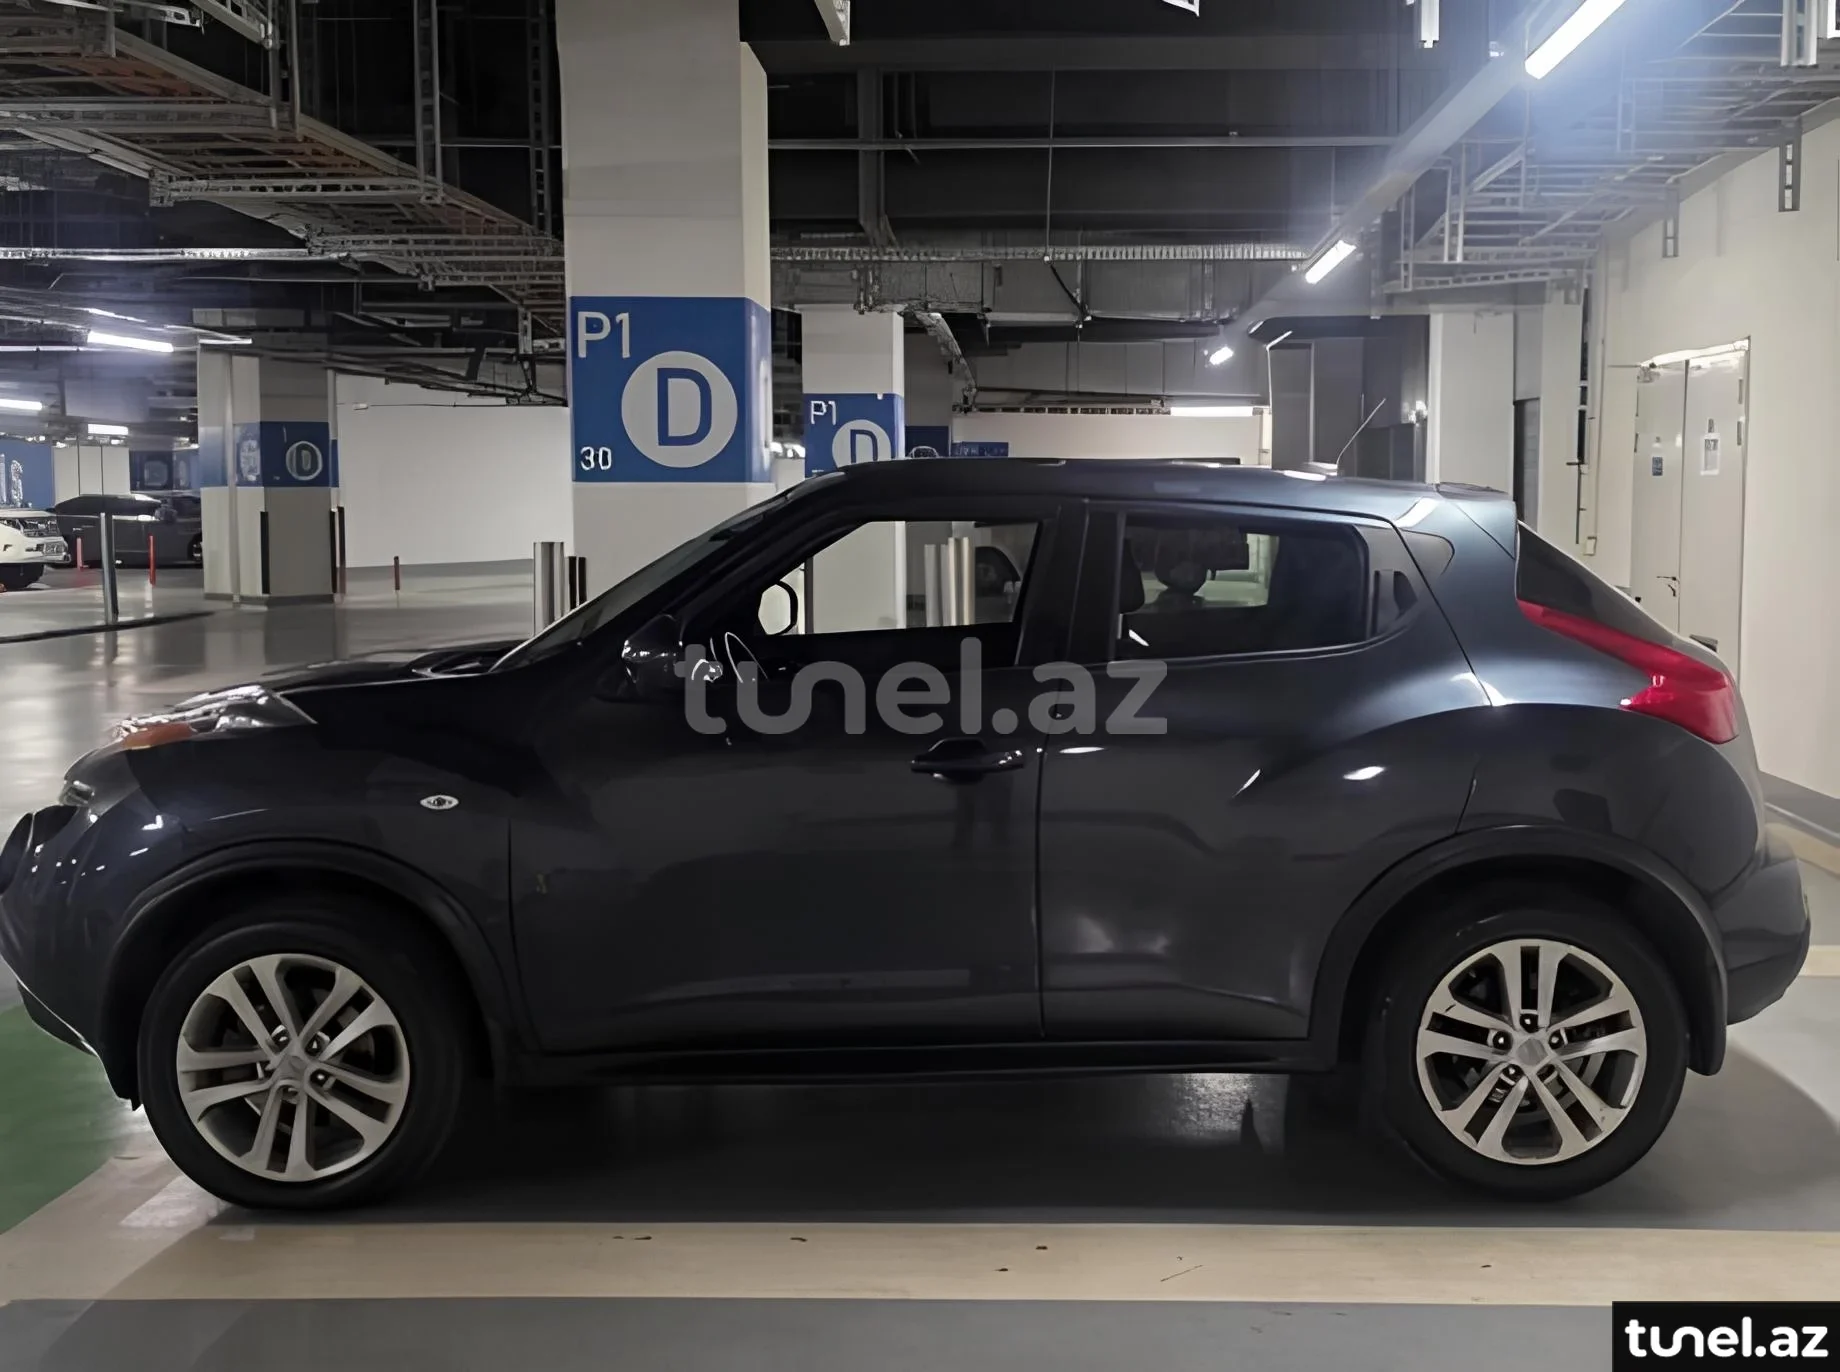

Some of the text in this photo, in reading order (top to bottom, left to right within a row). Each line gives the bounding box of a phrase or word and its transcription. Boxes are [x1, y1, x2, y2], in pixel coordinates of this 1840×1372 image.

[577, 311, 631, 359] P1
[656, 367, 713, 447] D
[810, 400, 837, 426] P1
[580, 446, 612, 470] 30
